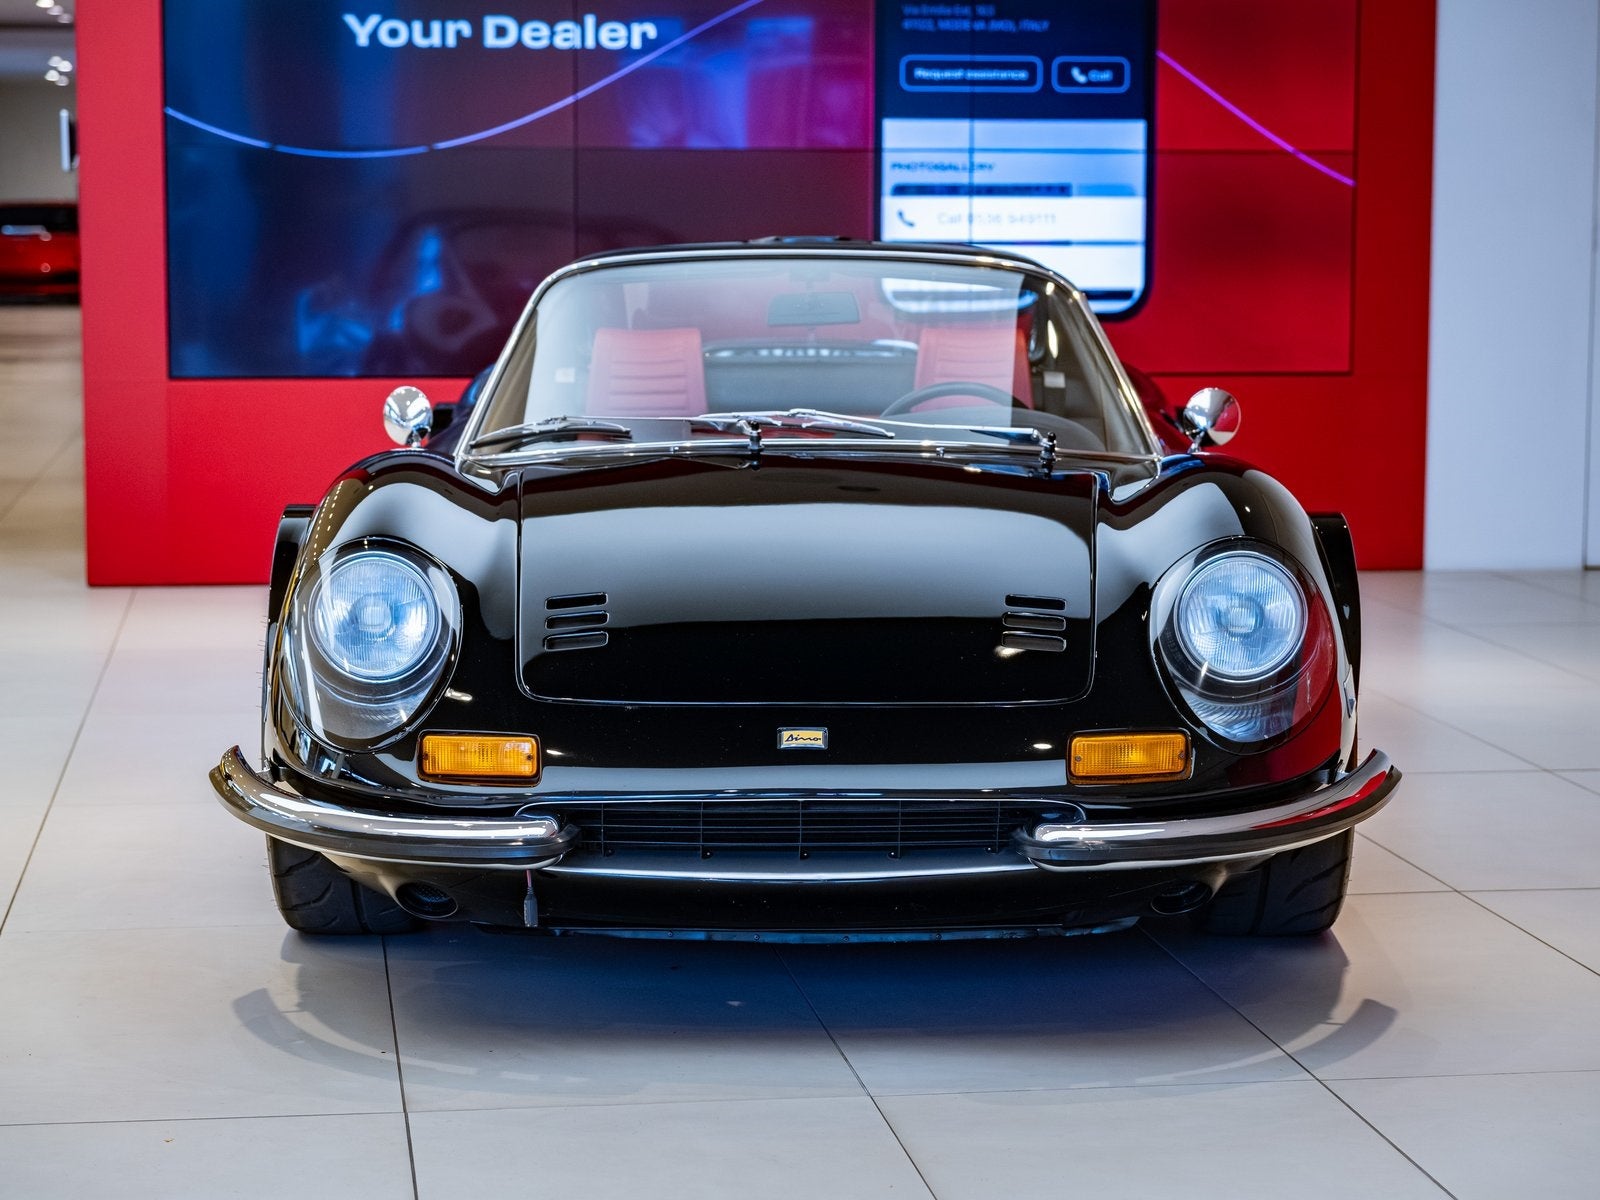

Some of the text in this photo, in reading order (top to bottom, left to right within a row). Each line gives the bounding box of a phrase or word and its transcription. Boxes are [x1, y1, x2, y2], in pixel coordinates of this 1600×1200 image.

[342, 13, 657, 50] Your Dealer
[914, 67, 1029, 81] Request assistance
[1087, 69, 1114, 81] Call
[937, 213, 962, 224] Call
[785, 733, 822, 742] Dino
